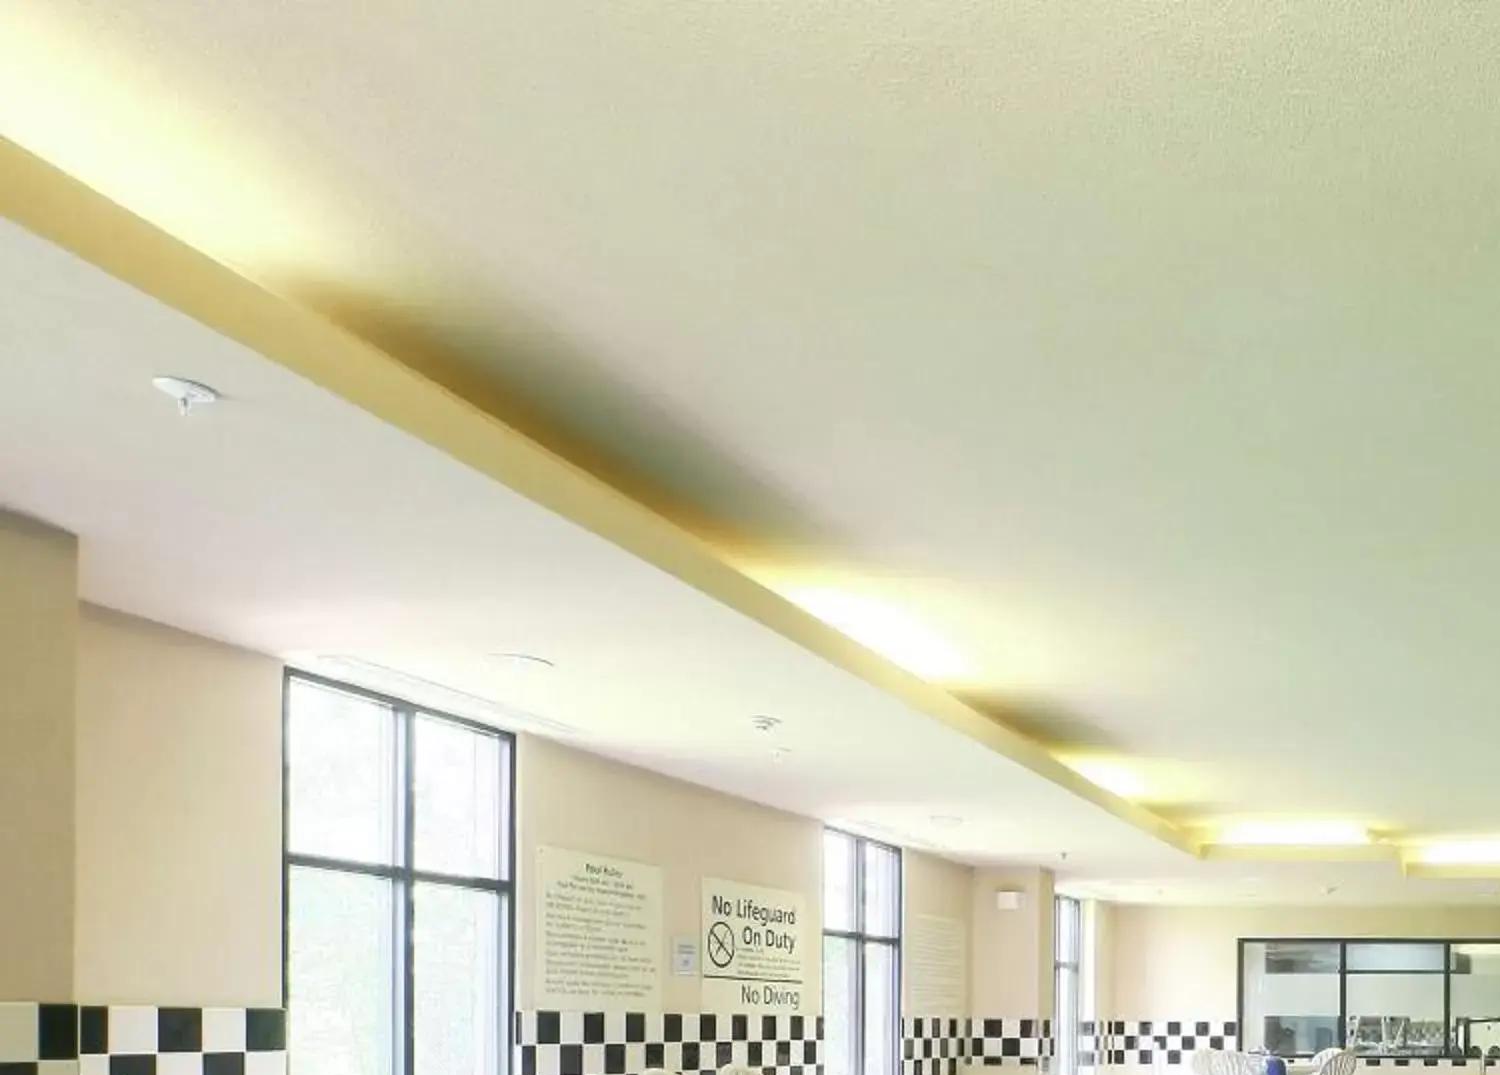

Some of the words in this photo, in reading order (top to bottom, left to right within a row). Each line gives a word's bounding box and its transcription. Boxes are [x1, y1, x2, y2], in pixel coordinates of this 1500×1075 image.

[711, 896, 733, 917] No
[737, 899, 796, 926] Lifeguard
[743, 926, 761, 946] On
[765, 929, 796, 955] Duty
[741, 984, 760, 1005] No
[763, 985, 801, 1010] Diving
